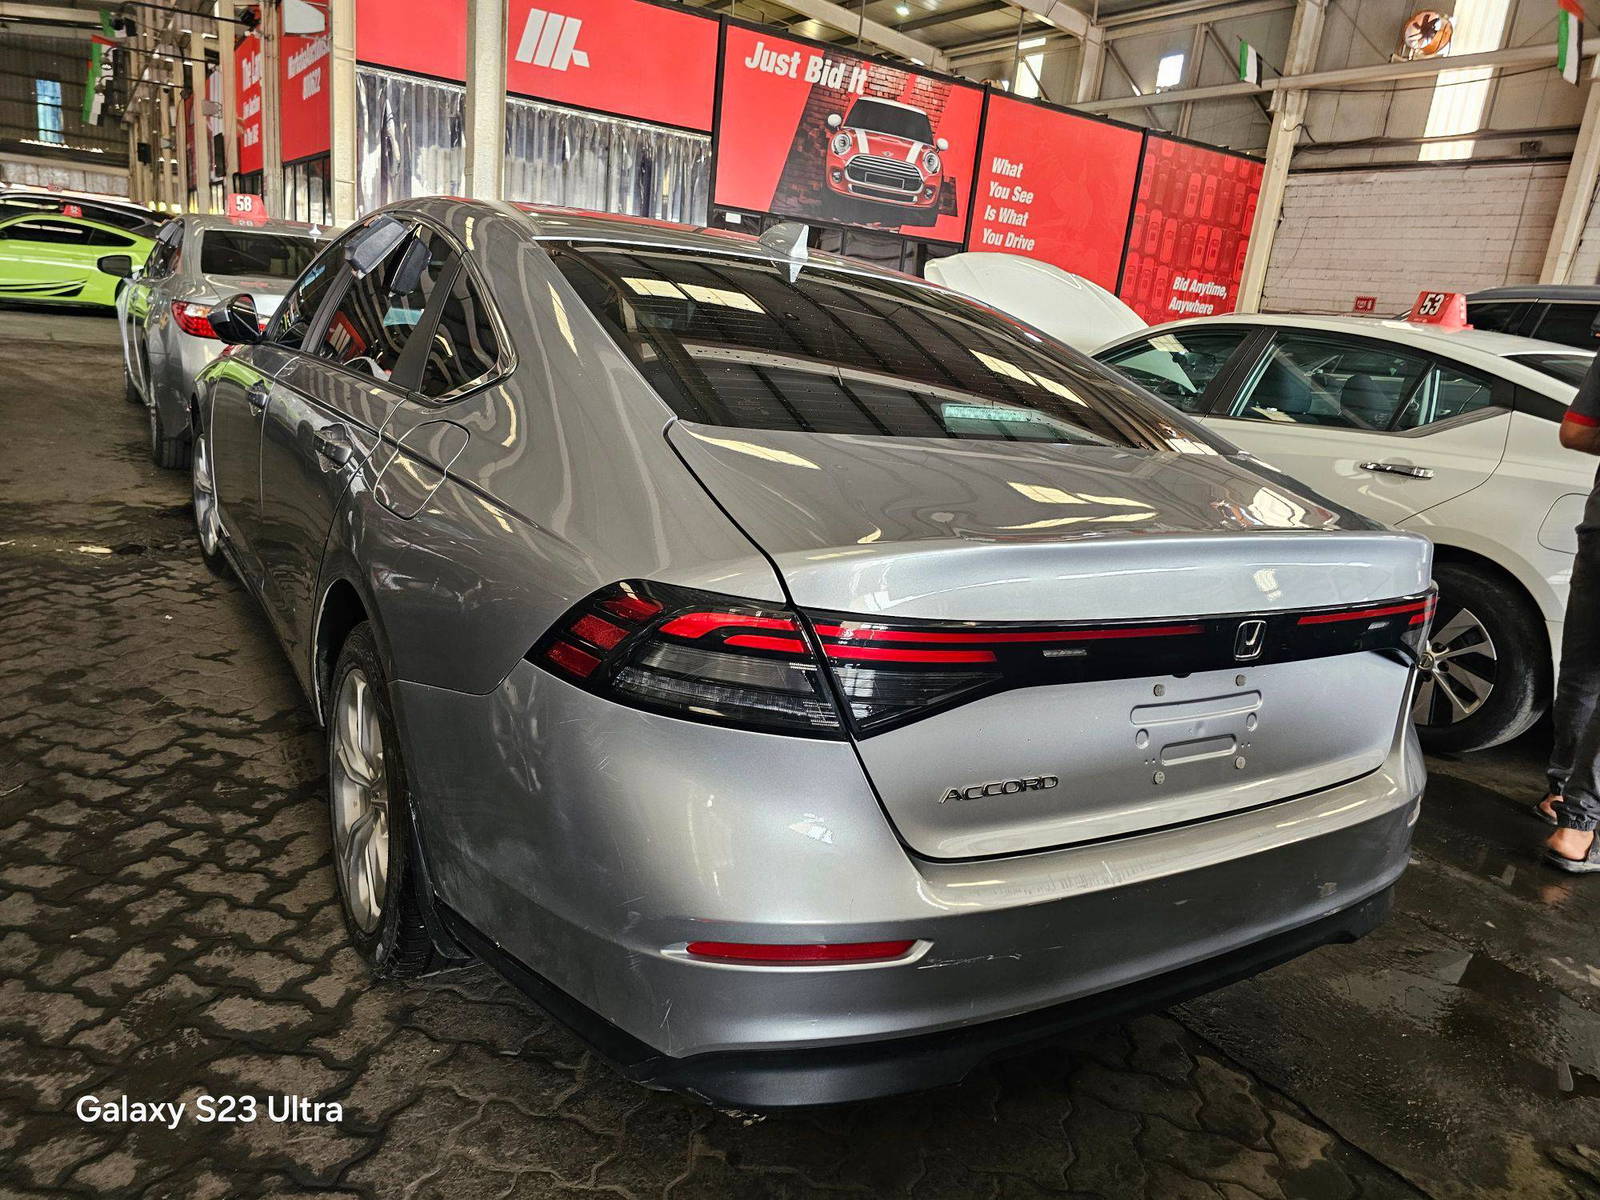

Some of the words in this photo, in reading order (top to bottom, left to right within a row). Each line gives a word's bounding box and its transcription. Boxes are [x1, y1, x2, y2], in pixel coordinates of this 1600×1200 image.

[745, 41, 801, 79] Just
[804, 55, 846, 89] Bid
[847, 66, 868, 95] It
[992, 157, 1023, 178] What
[236, 195, 252, 212] 58
[989, 180, 1011, 200] You
[1011, 185, 1034, 205] See
[984, 204, 997, 221] Is
[998, 207, 1029, 227] What
[982, 227, 1004, 246] You
[1004, 231, 1035, 251] Drive
[1172, 276, 1190, 291] Bid
[1189, 279, 1227, 300] Anytime,
[1168, 296, 1214, 315] Anywhere
[1419, 293, 1445, 316] 53
[938, 774, 1059, 804] ACCORD
